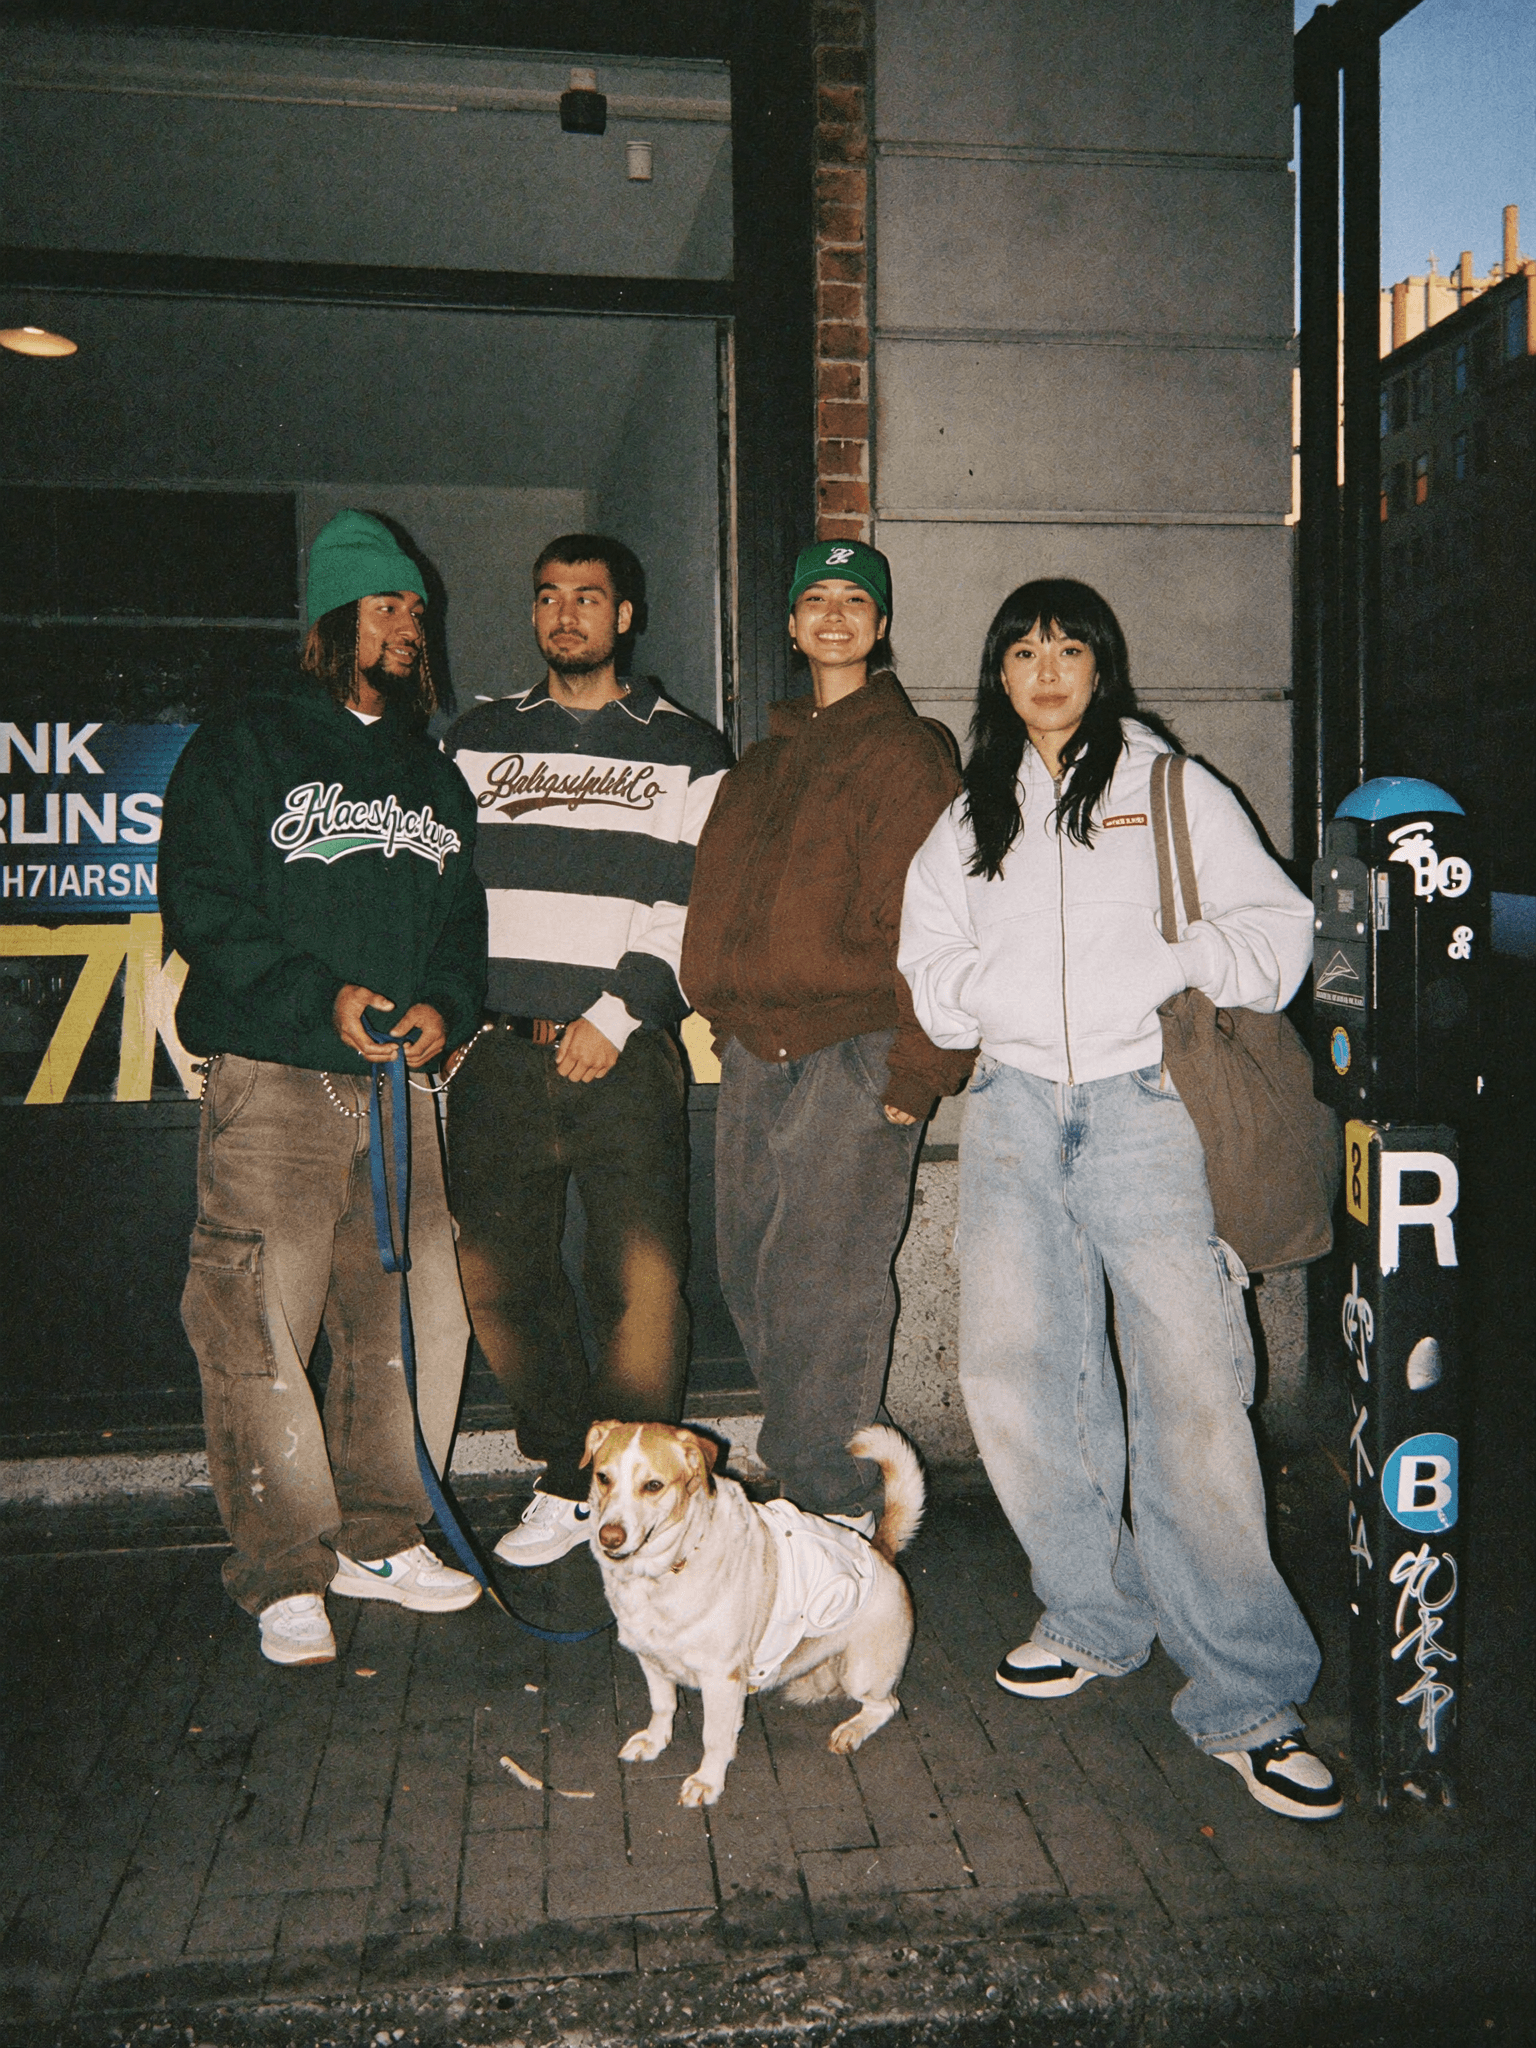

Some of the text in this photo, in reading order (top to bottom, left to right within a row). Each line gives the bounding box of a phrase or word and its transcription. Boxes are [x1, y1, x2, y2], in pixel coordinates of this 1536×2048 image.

[0, 722, 105, 774] NK
[1379, 1151, 1460, 1270] R
[1396, 1454, 1453, 1513] B
